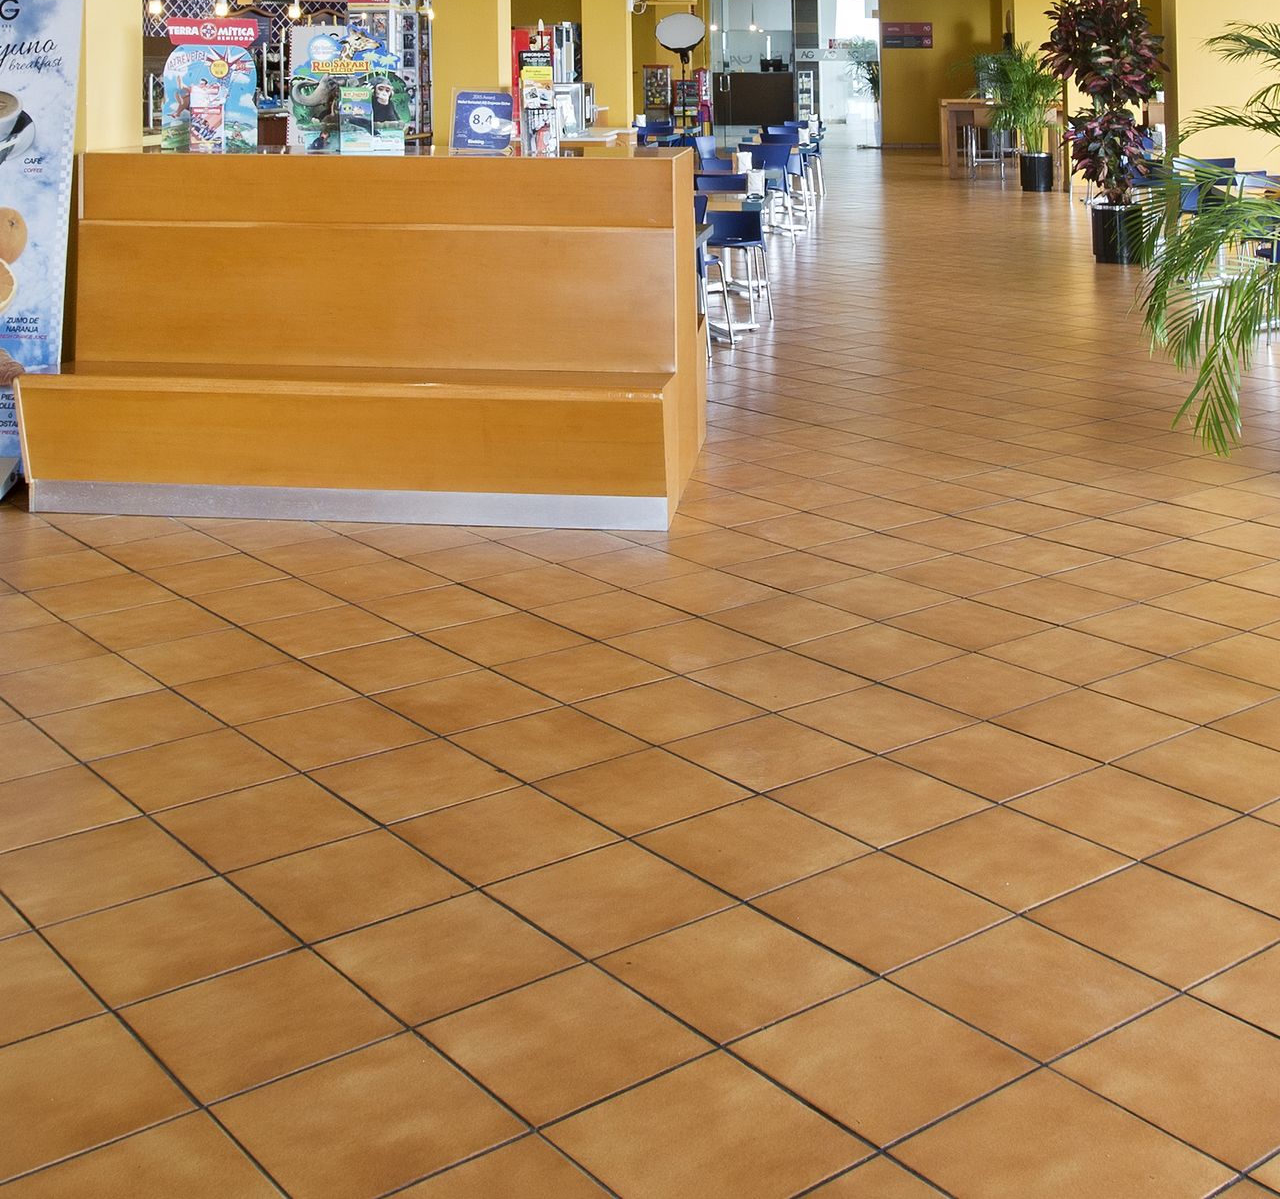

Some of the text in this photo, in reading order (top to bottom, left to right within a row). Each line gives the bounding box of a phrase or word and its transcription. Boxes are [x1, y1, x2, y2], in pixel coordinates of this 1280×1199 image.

[167, 26, 254, 36] TERRA MÍTICA
[801, 51, 814, 59] AG
[9, 55, 63, 73] breakfast
[312, 60, 369, 71] RIO SAFARI
[6, 325, 38, 333] NARANJA
